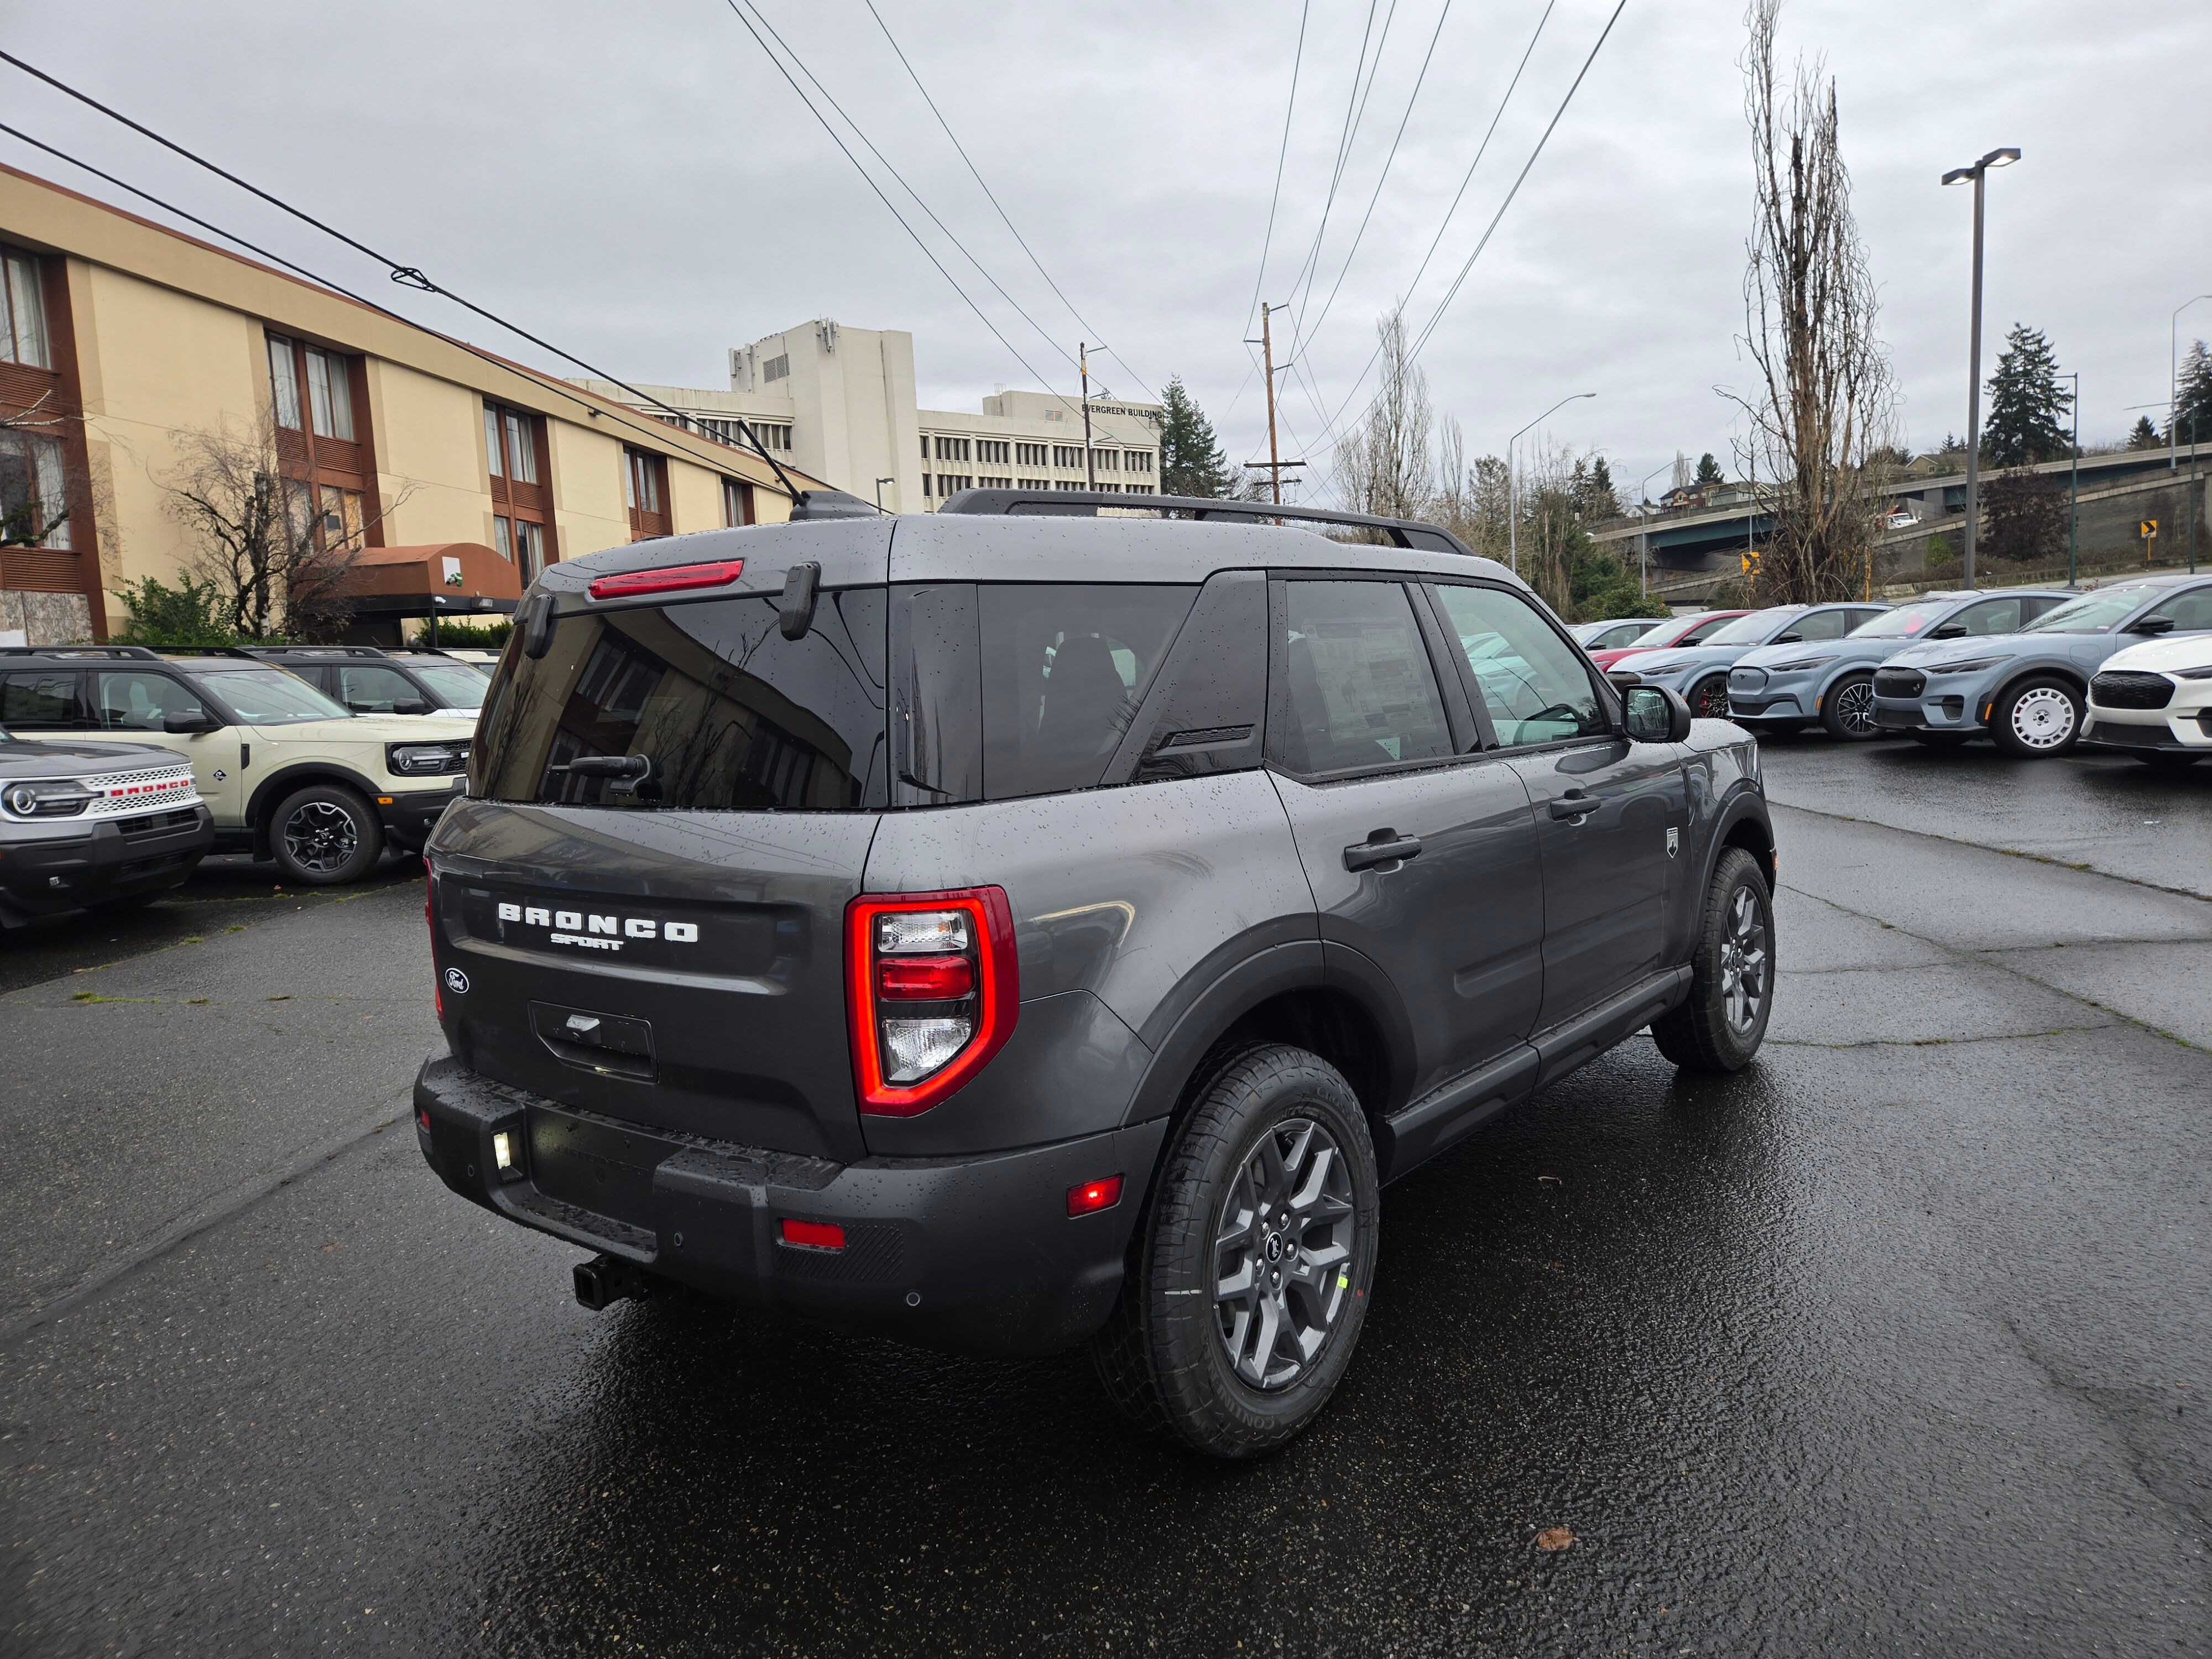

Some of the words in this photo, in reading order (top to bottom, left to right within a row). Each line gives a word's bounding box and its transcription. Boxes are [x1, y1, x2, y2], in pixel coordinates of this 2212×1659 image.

[1128, 408, 1162, 418] BUILDING
[110, 780, 189, 797] BRONCO
[498, 902, 698, 942] BRONCO
[550, 933, 624, 951] SPORT
[448, 970, 465, 990] Ford
